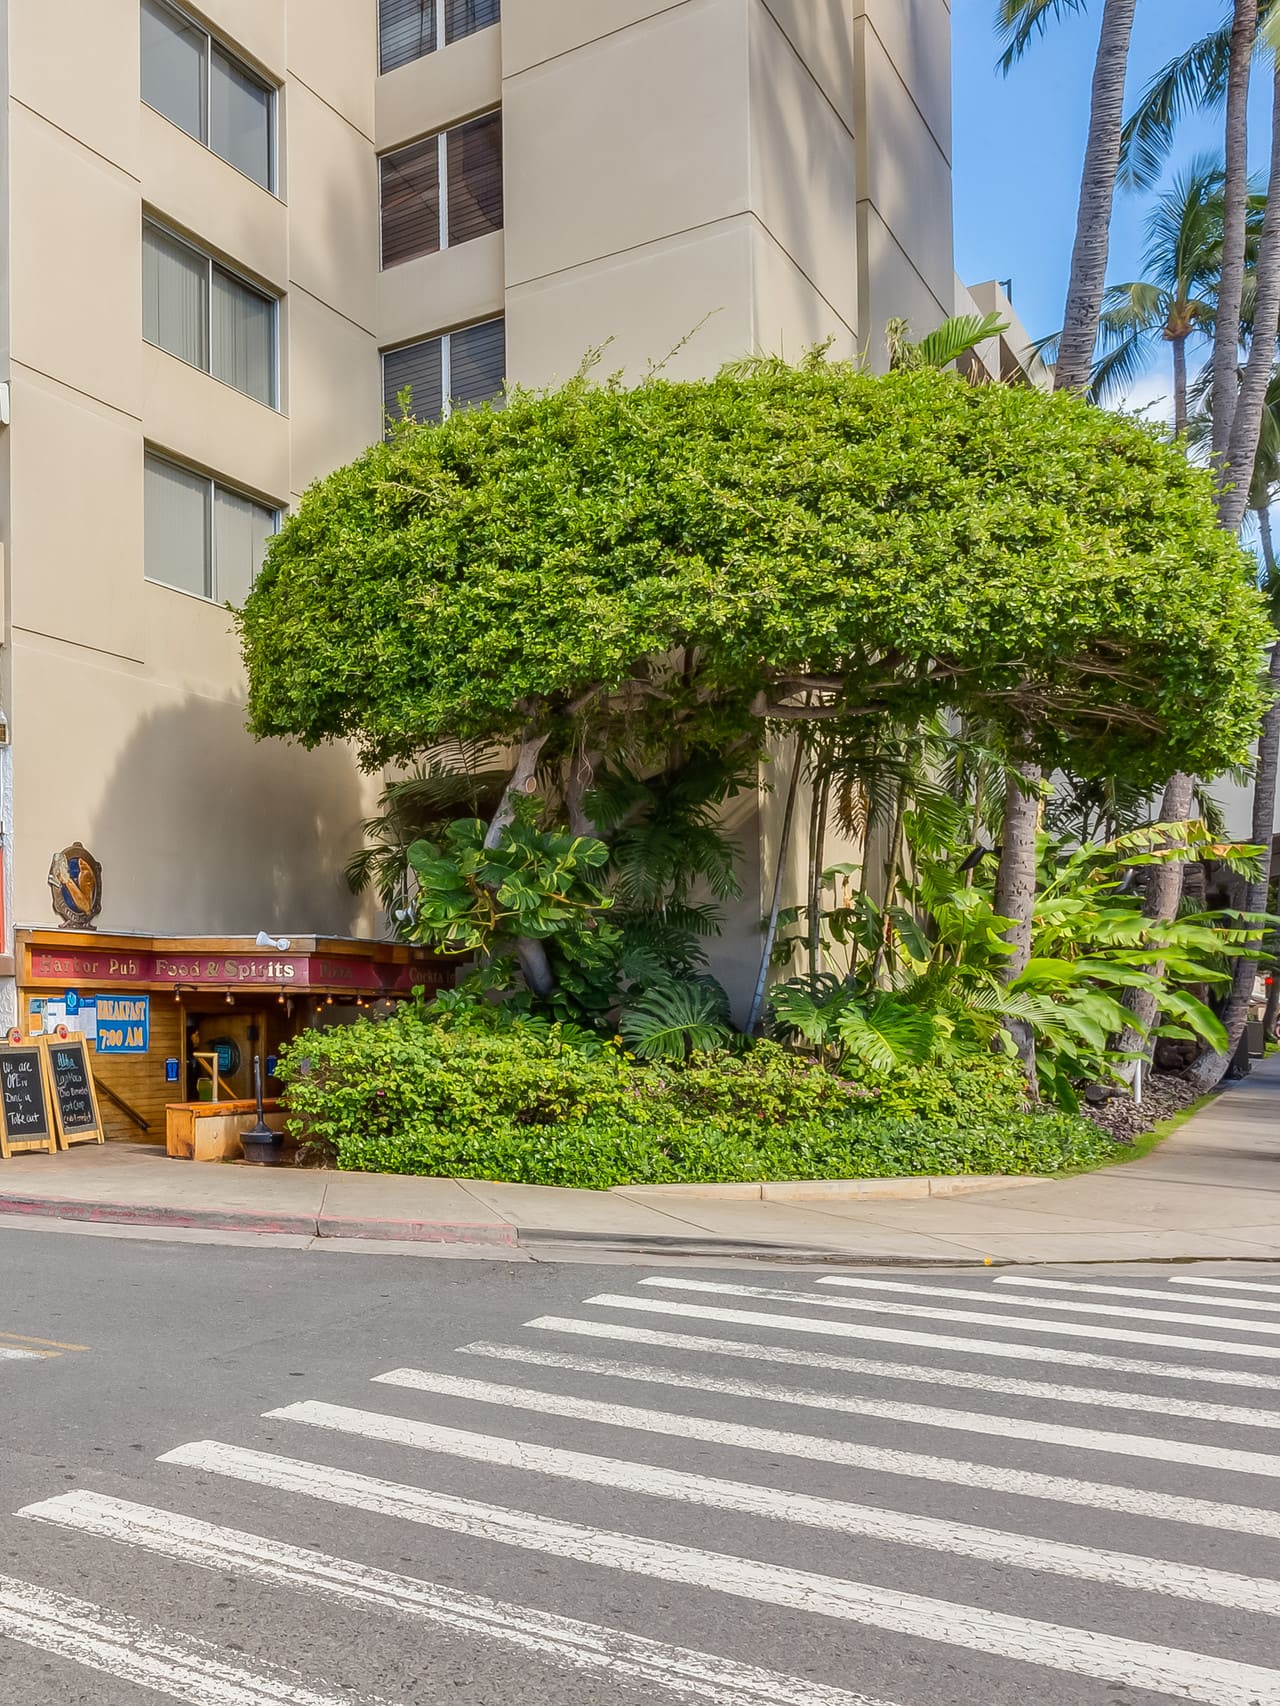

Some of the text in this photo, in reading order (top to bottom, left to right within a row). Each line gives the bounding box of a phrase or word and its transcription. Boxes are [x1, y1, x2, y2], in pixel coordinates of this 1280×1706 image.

[109, 957, 138, 976] Pub
[156, 959, 295, 980] Food & Spirits
[98, 999, 146, 1021] BREAKFAST
[100, 1026, 144, 1050] 7:00 AM
